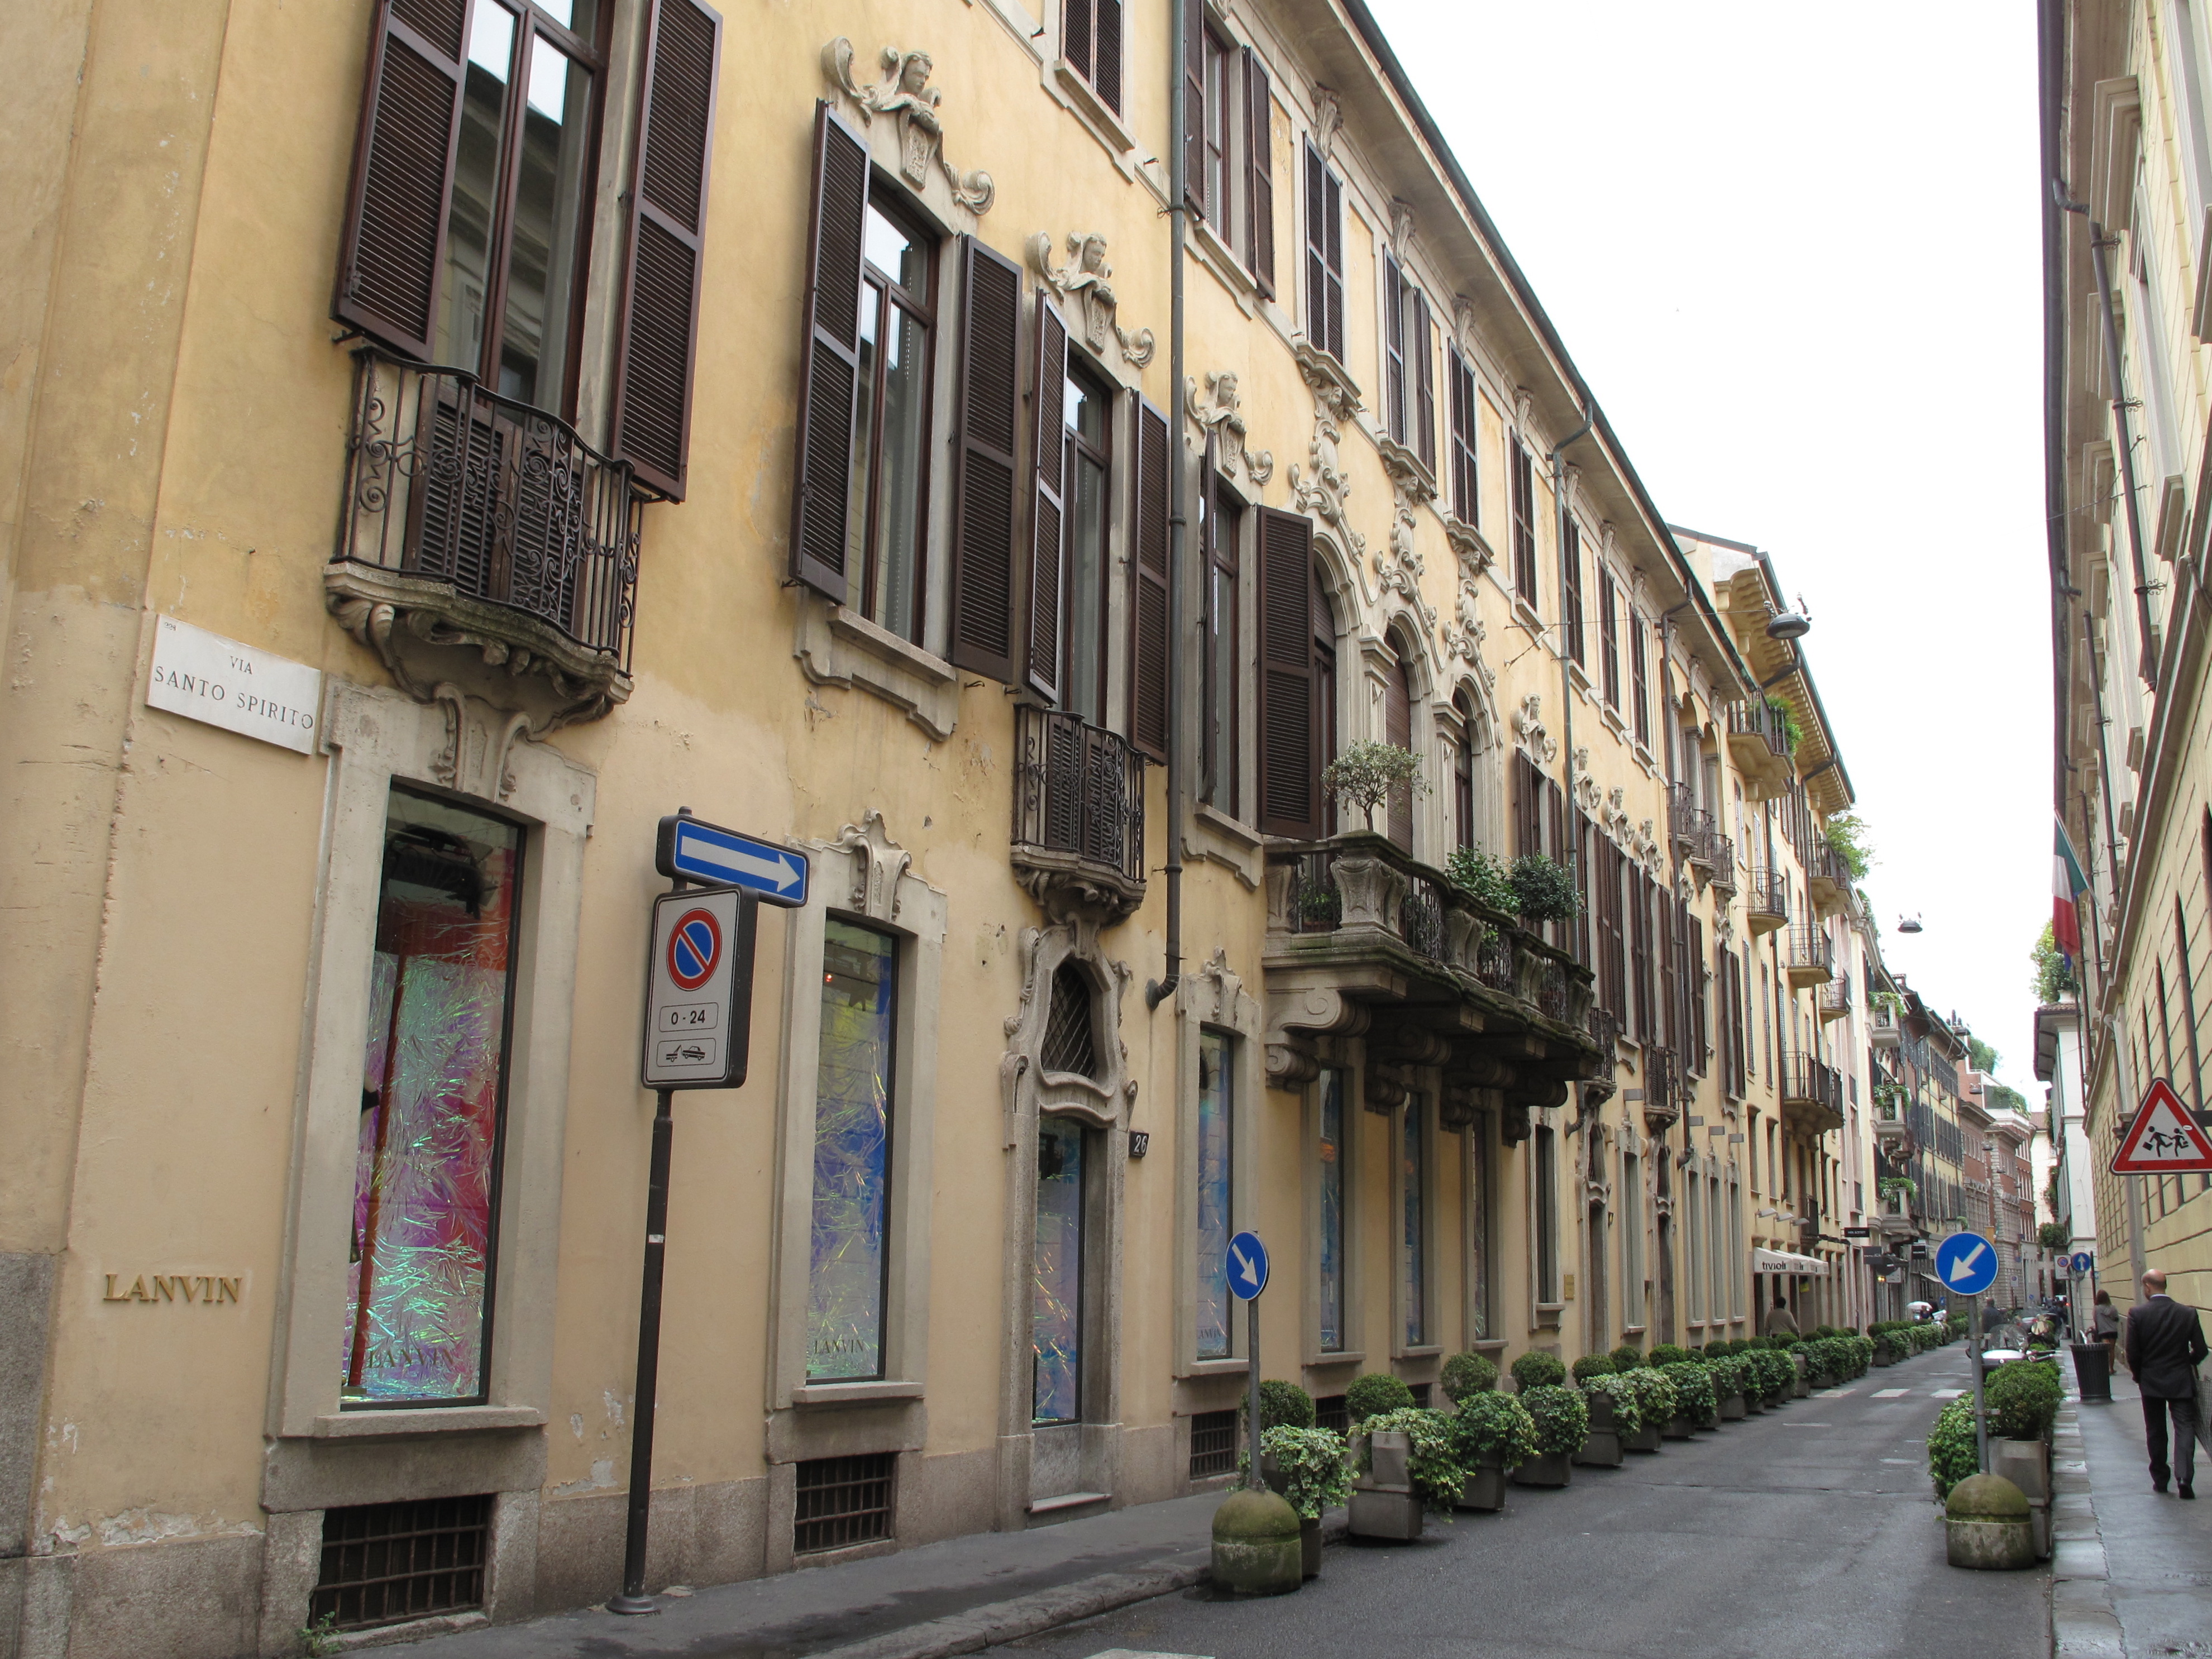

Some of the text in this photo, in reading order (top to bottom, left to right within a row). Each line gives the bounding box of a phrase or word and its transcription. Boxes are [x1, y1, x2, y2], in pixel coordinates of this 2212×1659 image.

[230, 656, 253, 675] VIA
[155, 666, 314, 729] SANTO SPIRITO
[671, 1011, 679, 1025] 0
[689, 1009, 705, 1024] 24
[1134, 1134, 1148, 1153] 26
[1762, 1260, 1786, 1270] tivoli
[103, 1273, 243, 1303] LANVIN
[814, 1338, 864, 1354] LANVIN
[365, 1347, 458, 1368] LANVIN
